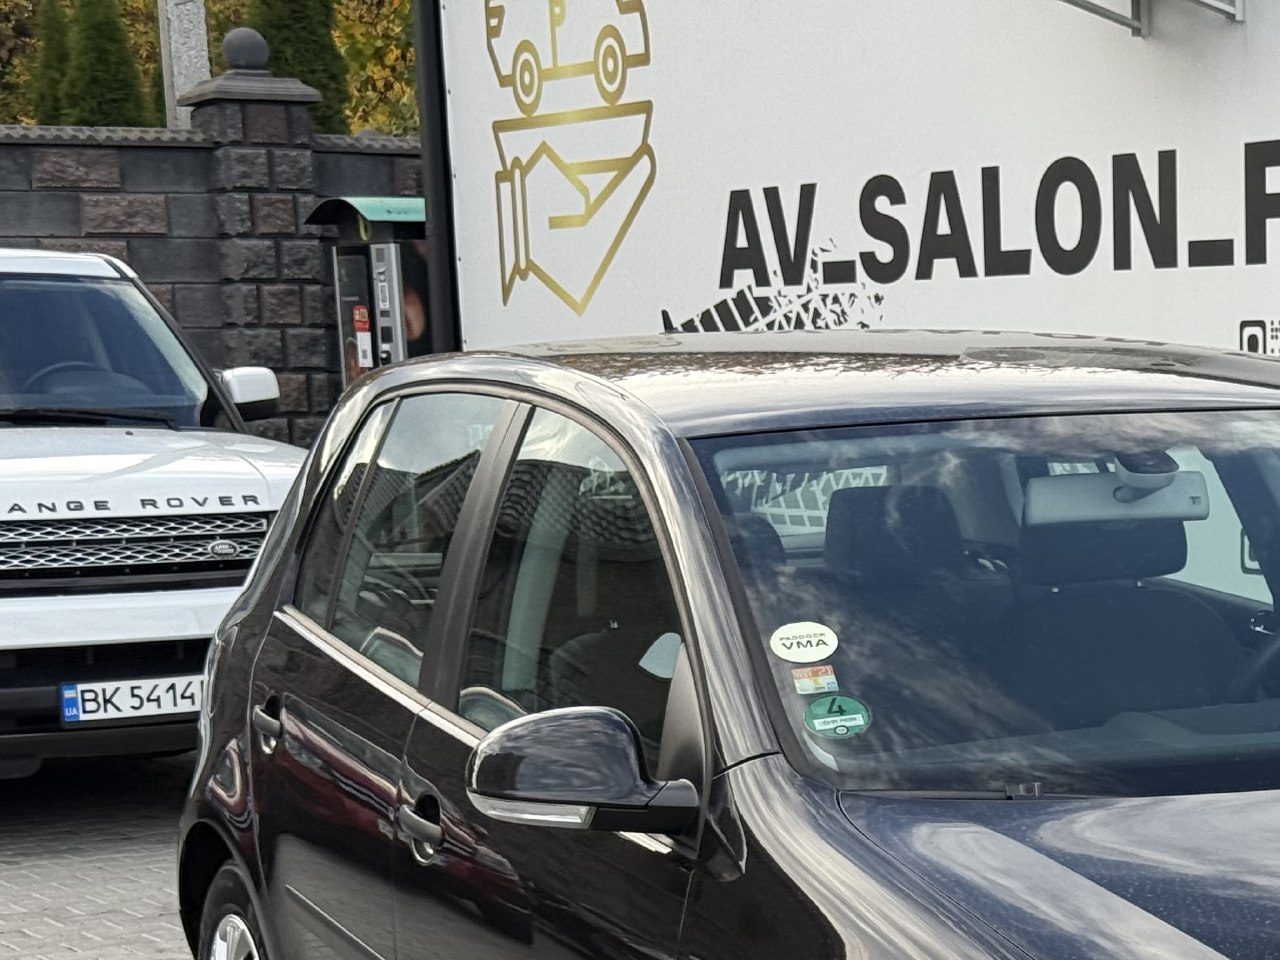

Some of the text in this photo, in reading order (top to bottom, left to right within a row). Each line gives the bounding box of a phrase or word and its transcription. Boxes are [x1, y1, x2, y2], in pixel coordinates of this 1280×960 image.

[140, 495, 261, 510] ROVER
[781, 638, 829, 650] VMA
[80, 681, 196, 715] BK 5414
[827, 697, 847, 716] 4
